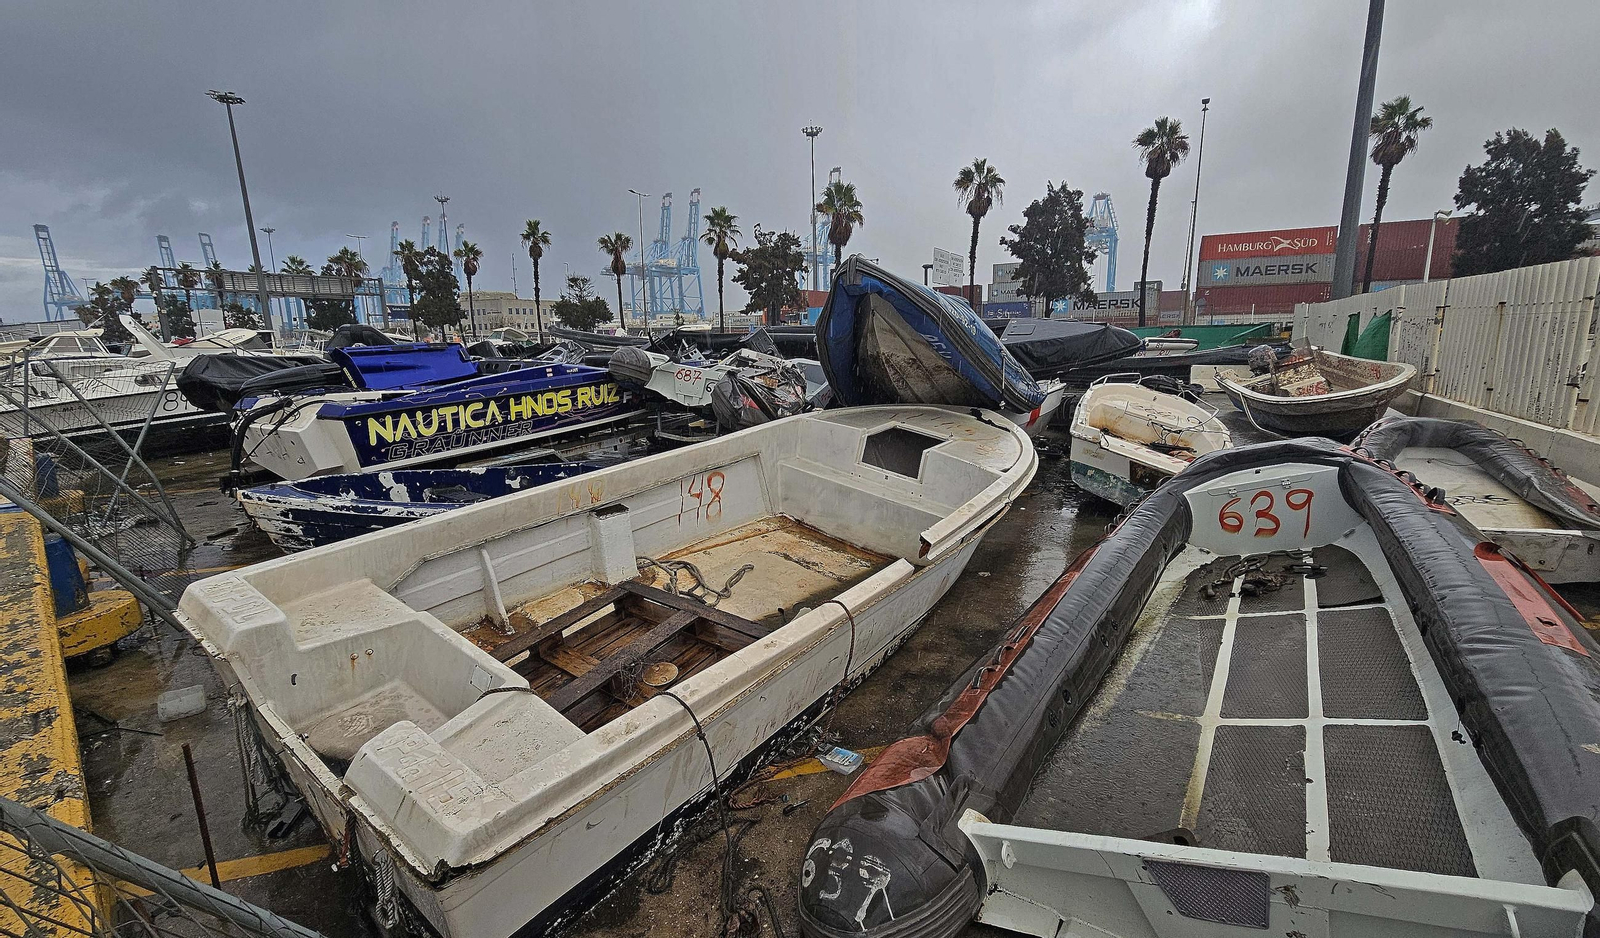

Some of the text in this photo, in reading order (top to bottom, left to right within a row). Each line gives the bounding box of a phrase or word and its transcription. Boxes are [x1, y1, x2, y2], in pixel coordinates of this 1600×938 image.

[1218, 241, 1272, 253] HAMBURG
[1294, 238, 1318, 250] SÜD
[1235, 262, 1318, 278] MAERSK
[1072, 298, 1141, 311] MAERSK
[674, 368, 703, 386] 687
[367, 383, 620, 446] NAUTICA HNOS RUIZ
[388, 420, 533, 462] GRAÜNNER
[678, 471, 725, 533] 148
[1218, 488, 1315, 539] 639
